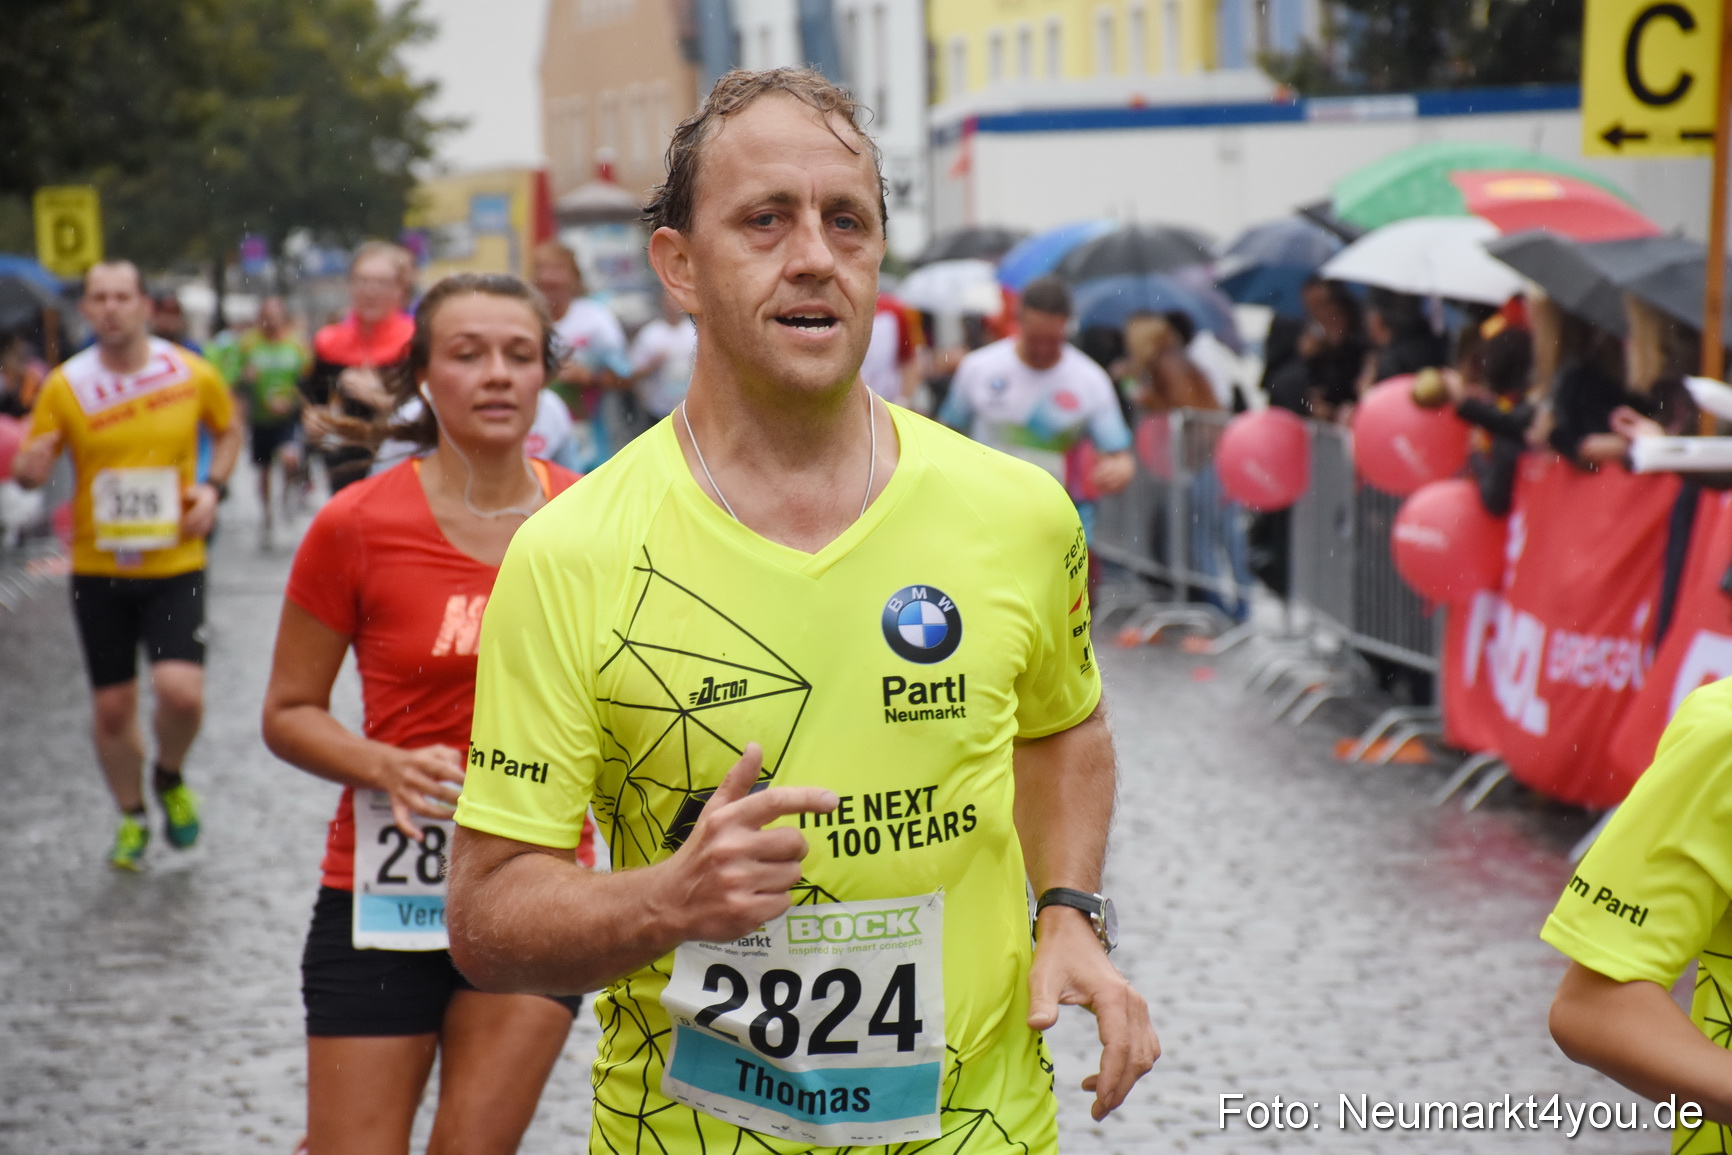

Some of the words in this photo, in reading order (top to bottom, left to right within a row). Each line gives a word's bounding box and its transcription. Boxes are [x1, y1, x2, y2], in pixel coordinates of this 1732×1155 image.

[1625, 2, 1697, 109] C
[887, 586, 954, 613] BMW
[882, 674, 966, 707] Partl
[884, 704, 967, 724] Neumarkt
[491, 748, 549, 784] Partl
[863, 784, 939, 823] NEXT
[826, 825, 882, 859] 100
[887, 803, 978, 852] YEARS
[786, 906, 922, 945] BOCK
[1592, 886, 1649, 928] Partl
[788, 946, 829, 956] inspired
[831, 945, 844, 956] by
[847, 943, 877, 954] smart
[880, 937, 923, 950] concepts
[693, 962, 923, 1060] 2824
[734, 1057, 871, 1116] Thomas
